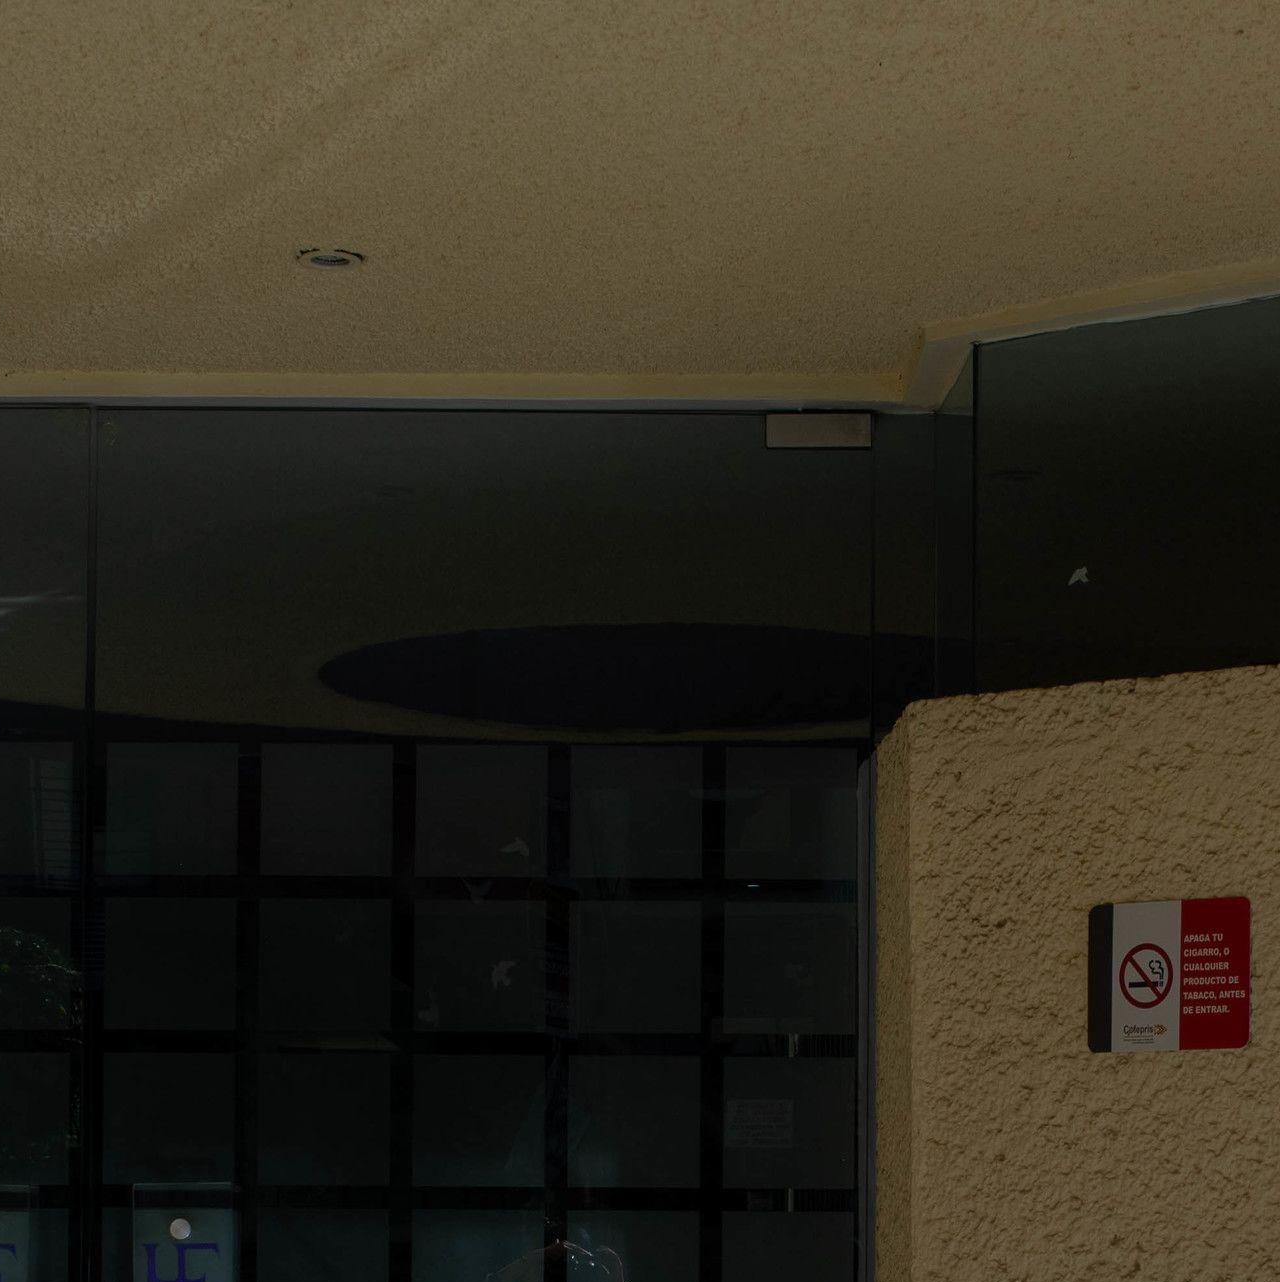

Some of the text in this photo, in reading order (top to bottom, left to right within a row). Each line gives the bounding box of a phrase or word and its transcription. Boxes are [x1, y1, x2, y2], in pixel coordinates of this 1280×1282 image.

[1184, 933, 1224, 943] APAGA TU
[1184, 947, 1230, 958] CIGARRO, O
[1183, 962, 1230, 971] CUALQUIER
[1183, 975, 1239, 986] PRODUCTO DE
[1183, 990, 1246, 1000] TABACO, ANTES
[1183, 1005, 1231, 1015] DE ENTRAR.
